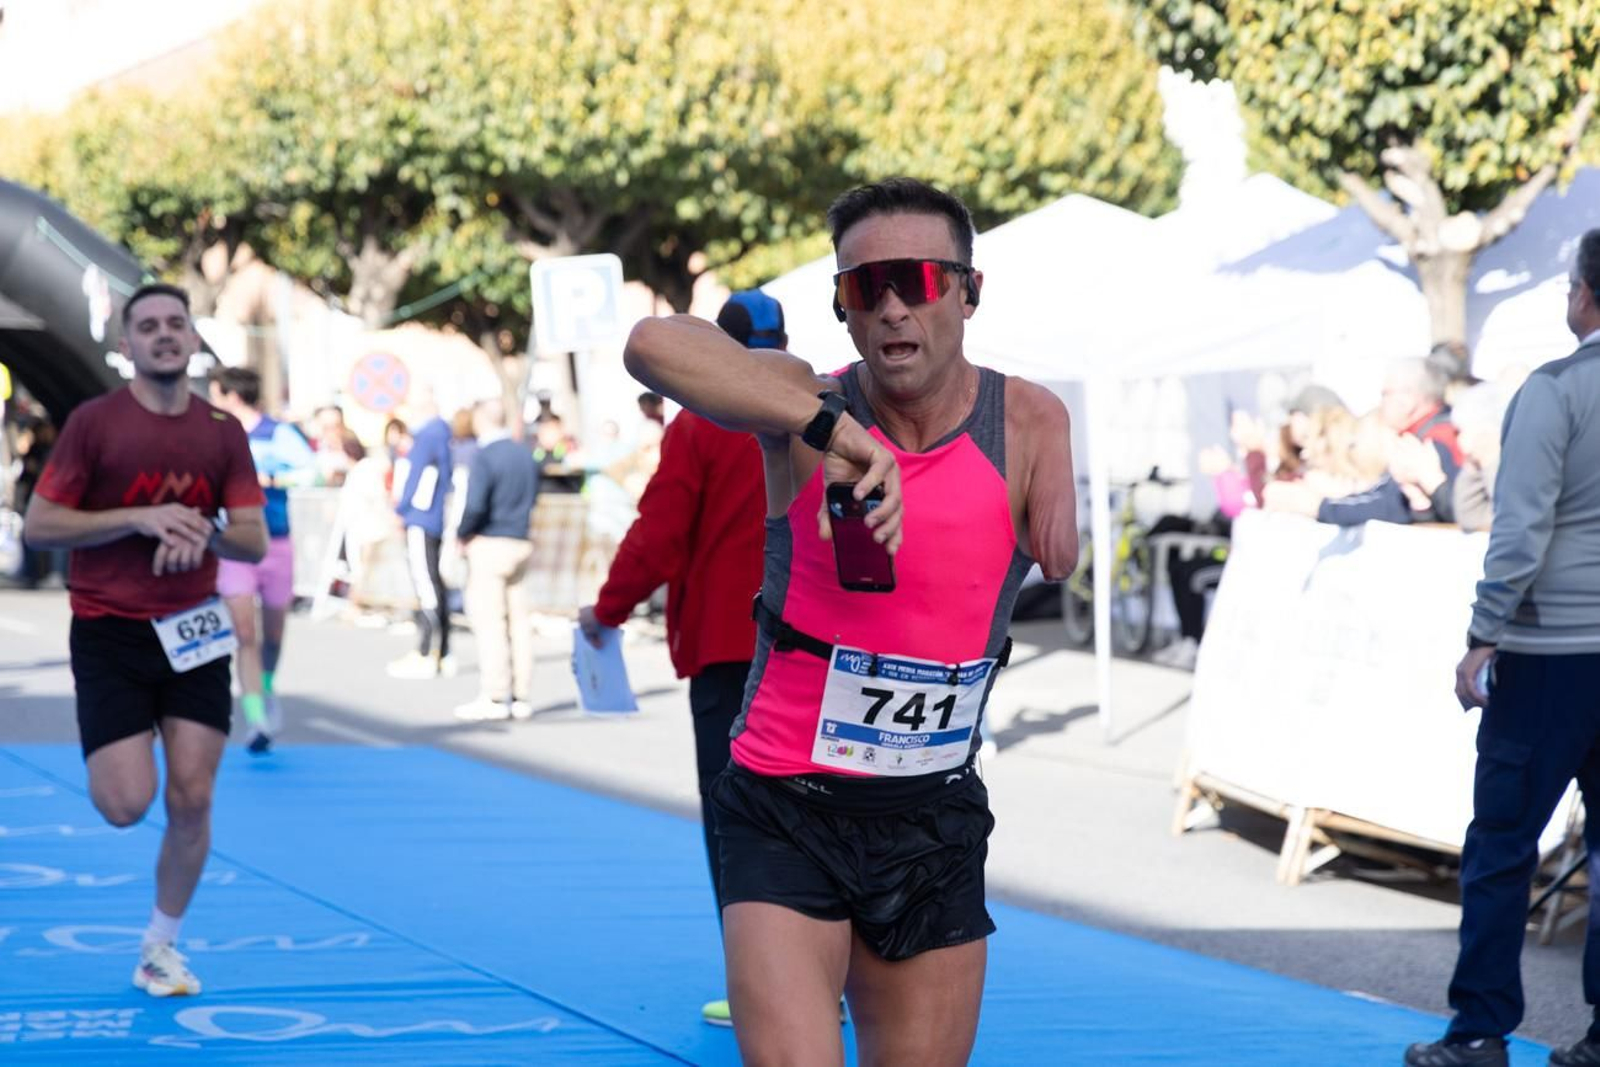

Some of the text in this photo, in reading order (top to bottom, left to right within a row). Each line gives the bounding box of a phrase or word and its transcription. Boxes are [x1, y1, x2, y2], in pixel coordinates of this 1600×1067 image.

[550, 268, 606, 343] P
[177, 610, 221, 641] 629
[861, 687, 957, 731] 741
[879, 731, 930, 745] FRANCISCO
